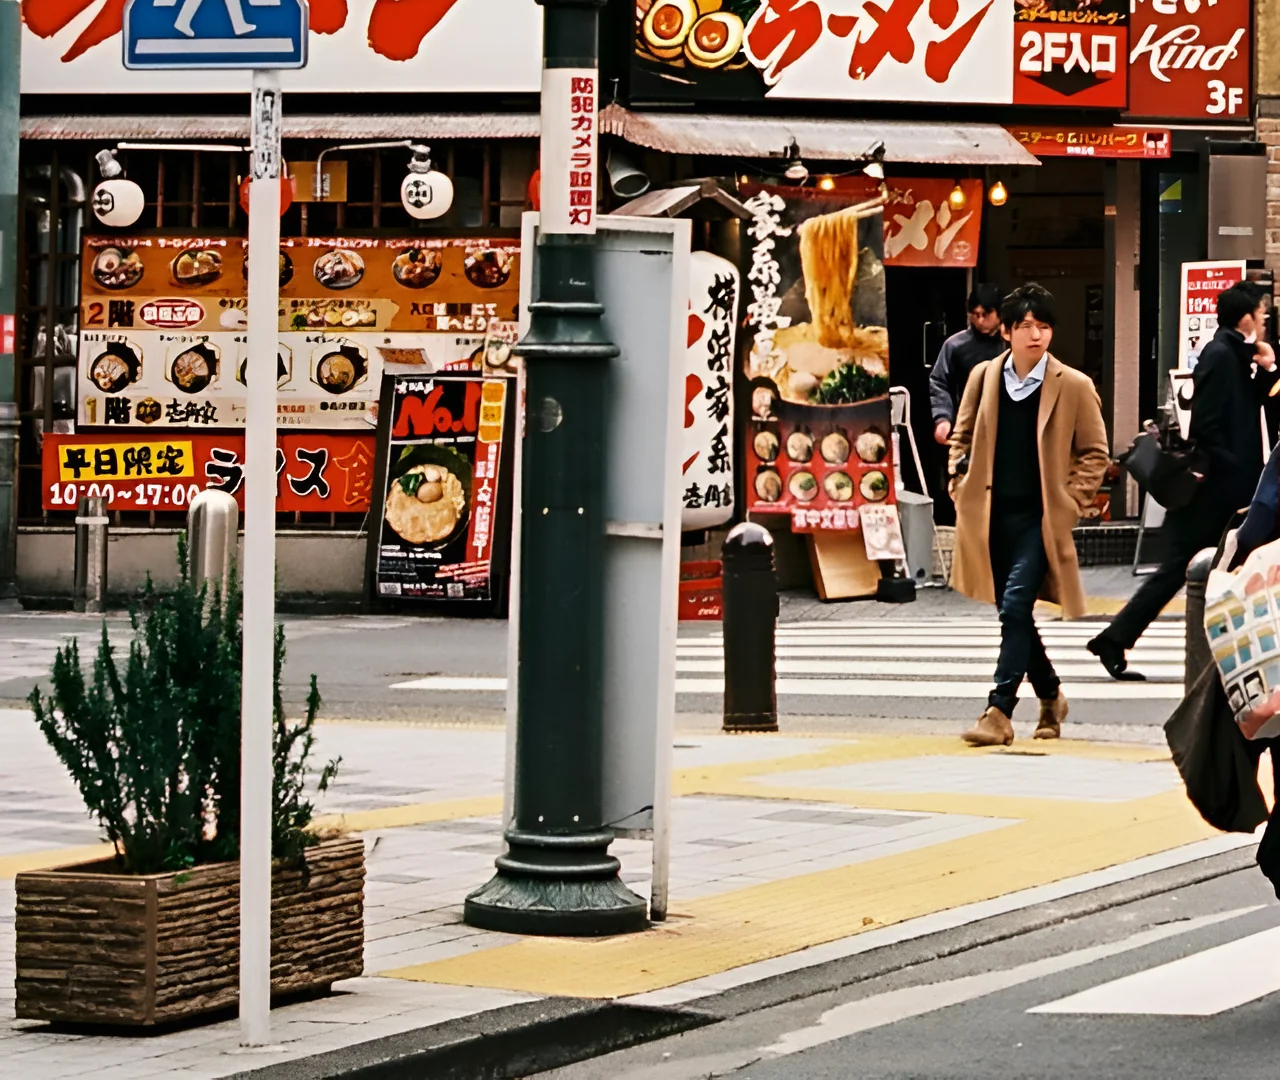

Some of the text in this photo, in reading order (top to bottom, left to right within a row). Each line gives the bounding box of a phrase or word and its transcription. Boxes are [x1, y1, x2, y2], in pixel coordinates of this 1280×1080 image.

[1019, 30, 1118, 74] 2F入口
[1129, 23, 1246, 83] Kind
[1205, 79, 1243, 115] 3F
[62, 444, 187, 478] 平日限定
[205, 446, 330, 498] ラス
